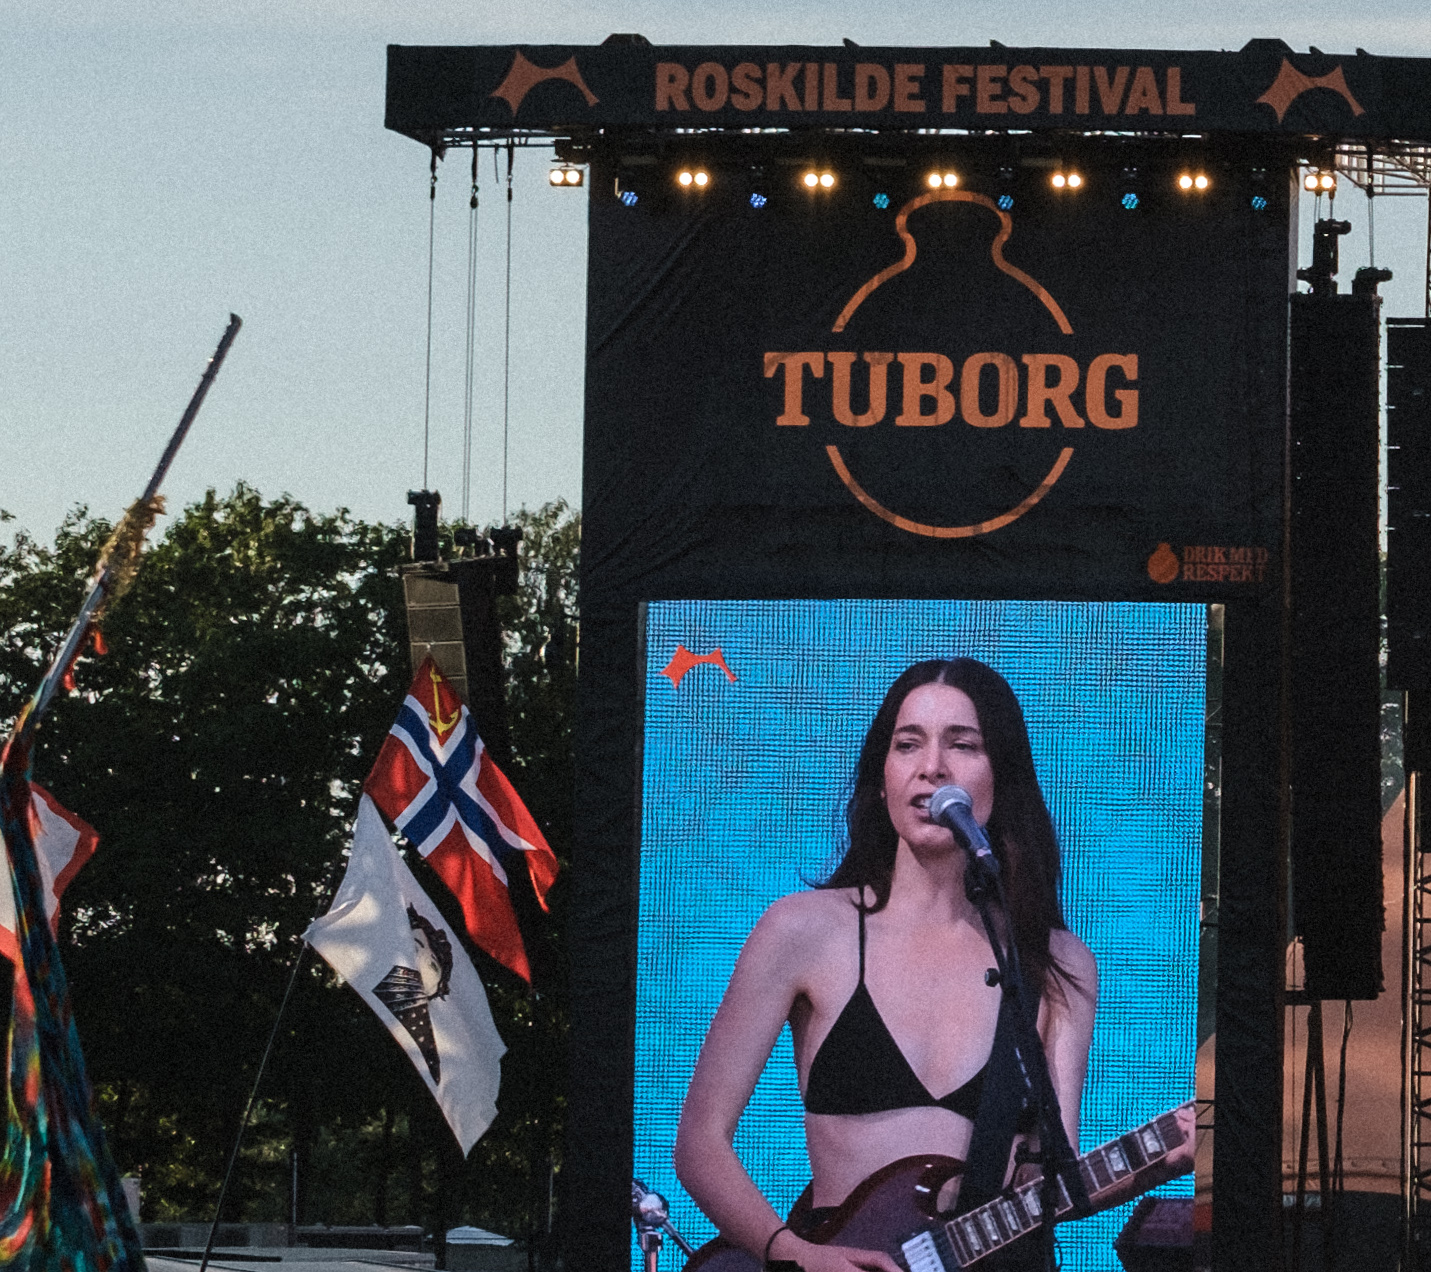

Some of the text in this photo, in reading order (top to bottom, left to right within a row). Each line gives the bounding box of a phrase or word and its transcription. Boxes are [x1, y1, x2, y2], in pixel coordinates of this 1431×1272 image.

[655, 61, 1196, 116] ROSKILDE FESTIVAL
[763, 351, 1139, 430] TUBORG
[1183, 545, 1226, 563] DRIK
